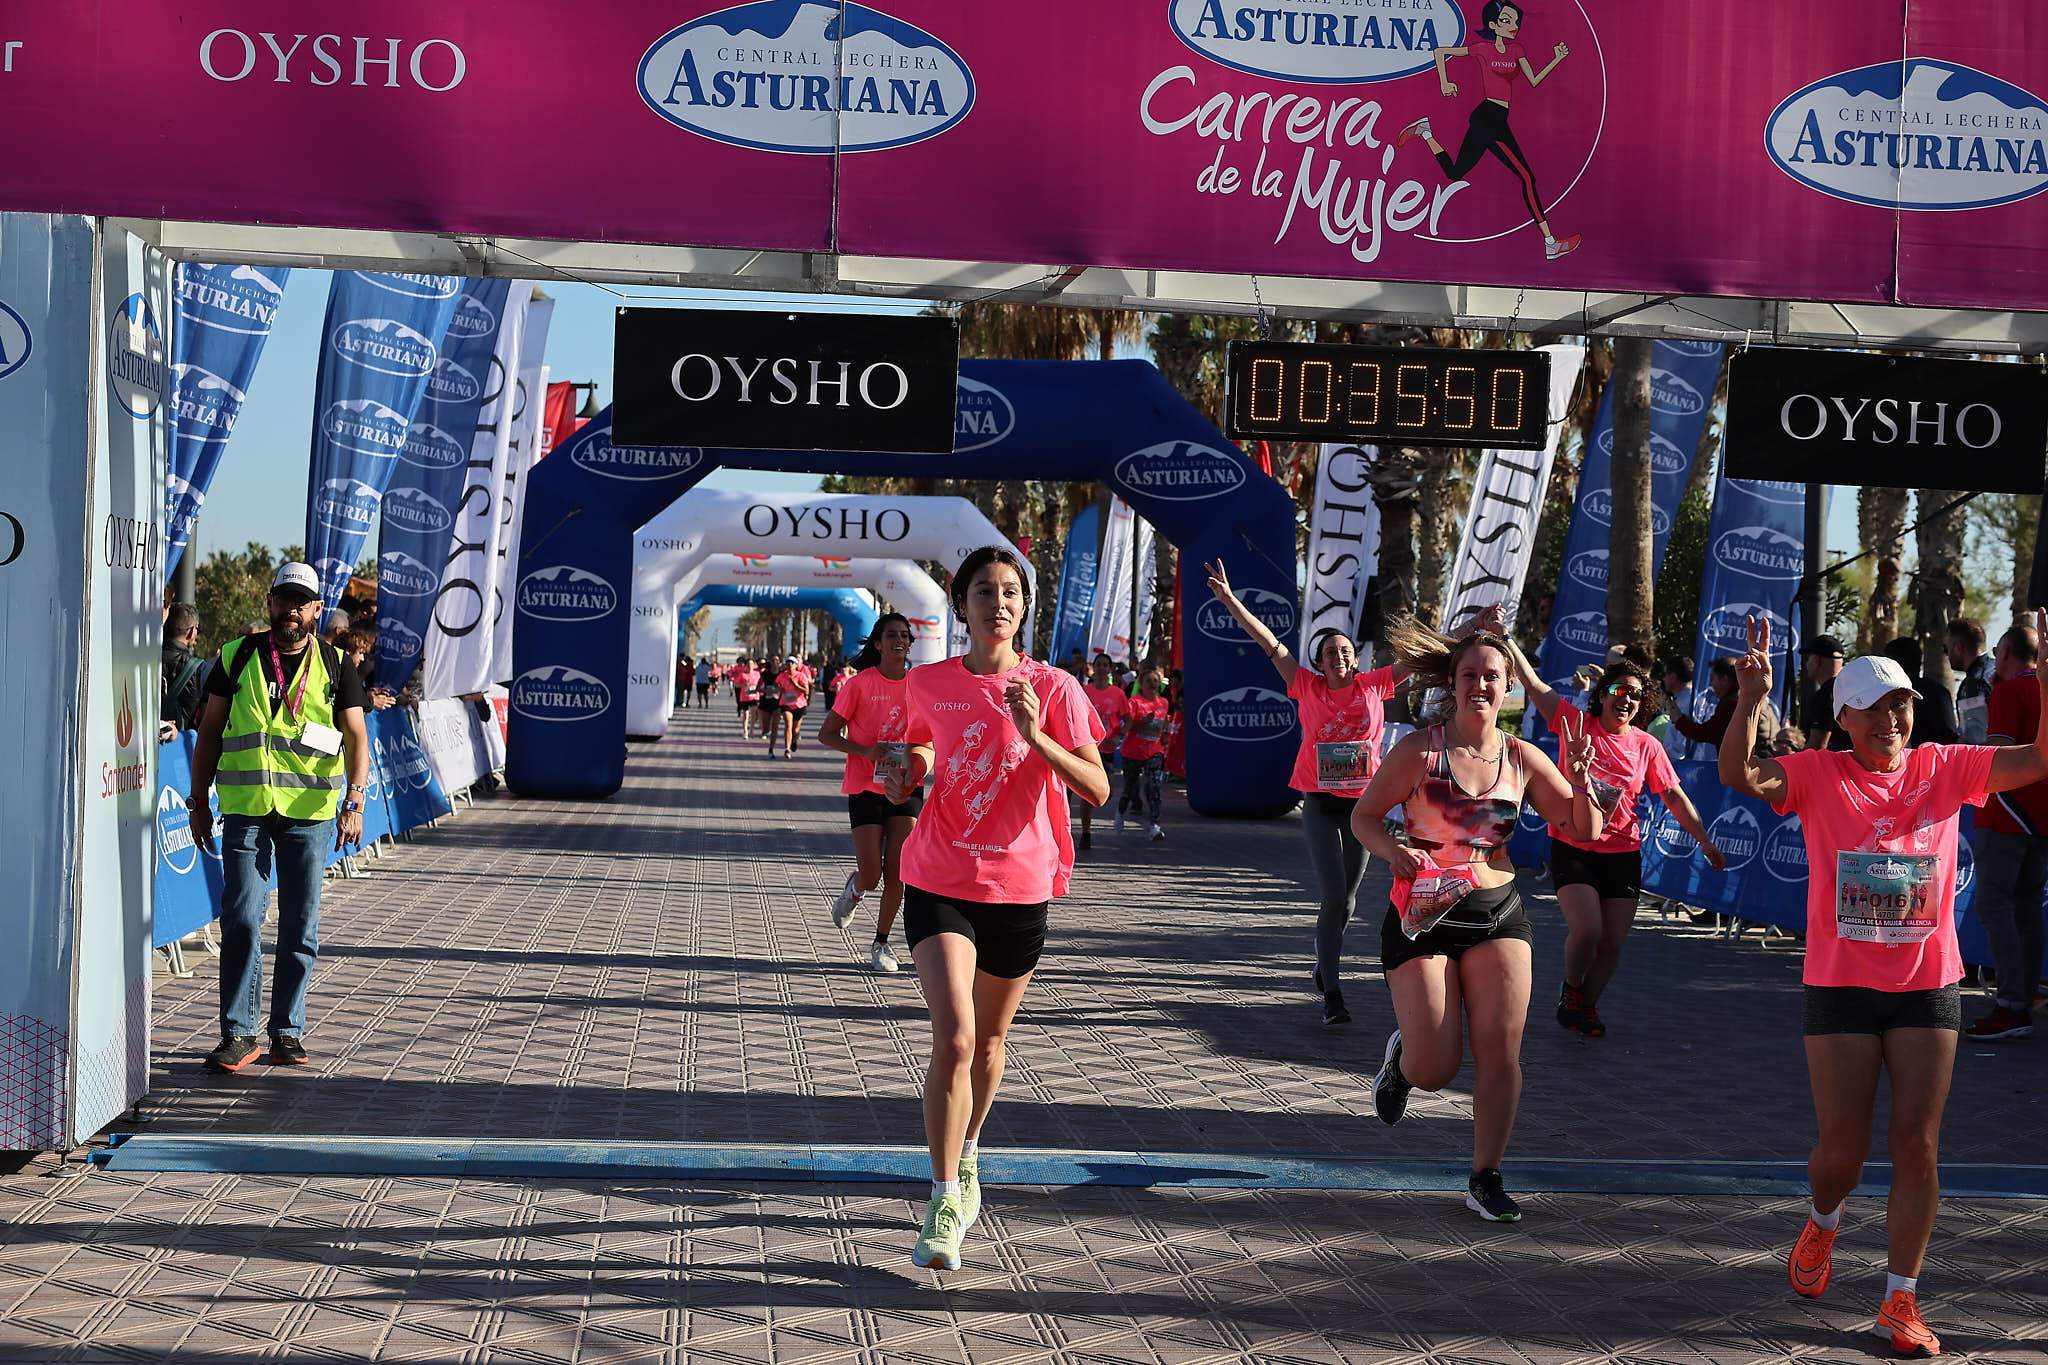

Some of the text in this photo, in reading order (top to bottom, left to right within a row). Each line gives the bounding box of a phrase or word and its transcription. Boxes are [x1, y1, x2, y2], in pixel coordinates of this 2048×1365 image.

[1191, 0, 1438, 52] ASTURIANA
[200, 28, 466, 91] OYSHO
[717, 47, 822, 66] CENTRAL
[662, 48, 949, 116] ASTURIANA
[1140, 65, 1381, 148] Carrera
[1838, 107, 2042, 130] CENTRAL LECHERA
[1788, 108, 2048, 174] ASTURIANA
[1196, 143, 1471, 263] de la Mujer
[112, 329, 160, 393] ASTURIANA
[338, 329, 430, 370] ASTURIANA
[671, 354, 909, 409] OYSHO
[1250, 358, 1524, 431] 00:35:50
[1780, 394, 2002, 449] OYSHO
[579, 441, 693, 467] ASTURIANA
[1126, 463, 1239, 486] ASTURIANA
[104, 513, 158, 573] OYSHO
[744, 504, 911, 542] OYSHO
[642, 539, 693, 551] OYSHO
[520, 584, 610, 610] ASTURIANA
[514, 684, 604, 709] ASTURIANA
[934, 702, 971, 712] OYSHO
[1204, 706, 1292, 728] ASTURIANA
[102, 759, 148, 800] Santander
[1841, 915, 1866, 925] CARRERA
[1846, 927, 1878, 937] OYSHO
